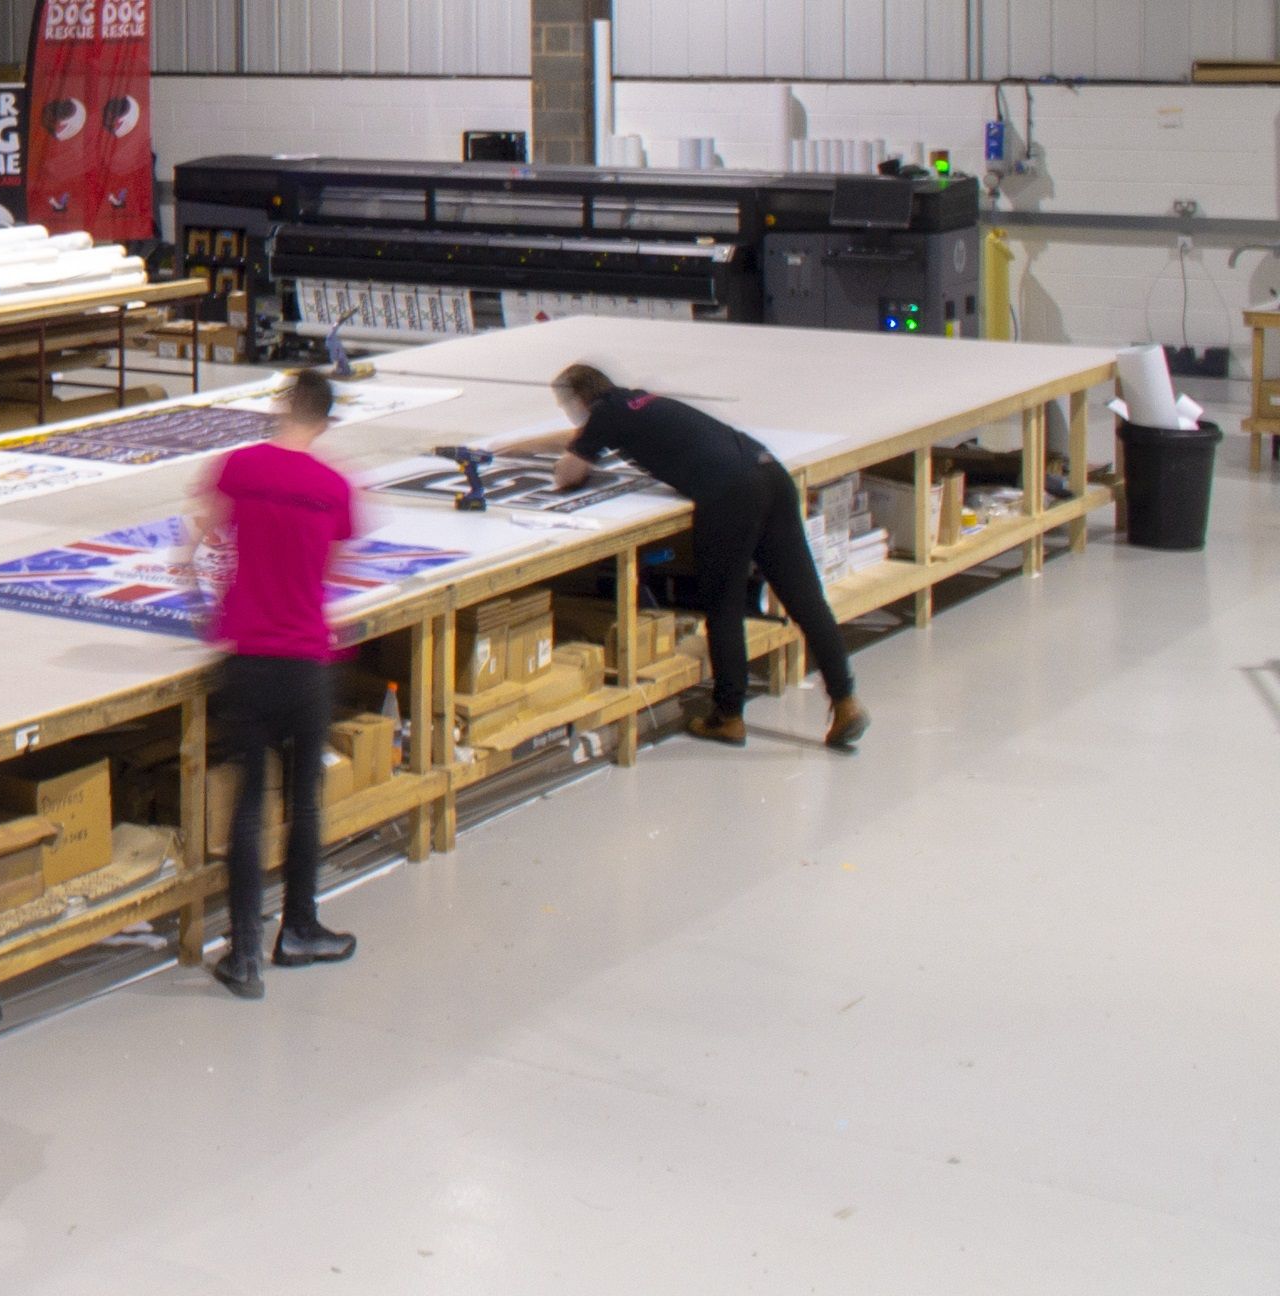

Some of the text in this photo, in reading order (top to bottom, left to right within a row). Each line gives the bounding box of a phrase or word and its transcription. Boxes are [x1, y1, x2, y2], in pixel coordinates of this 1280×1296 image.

[47, 2, 95, 25] DOG
[102, 1, 146, 24] DOG
[45, 24, 94, 40] RESCUE
[102, 22, 145, 39] RESCUE
